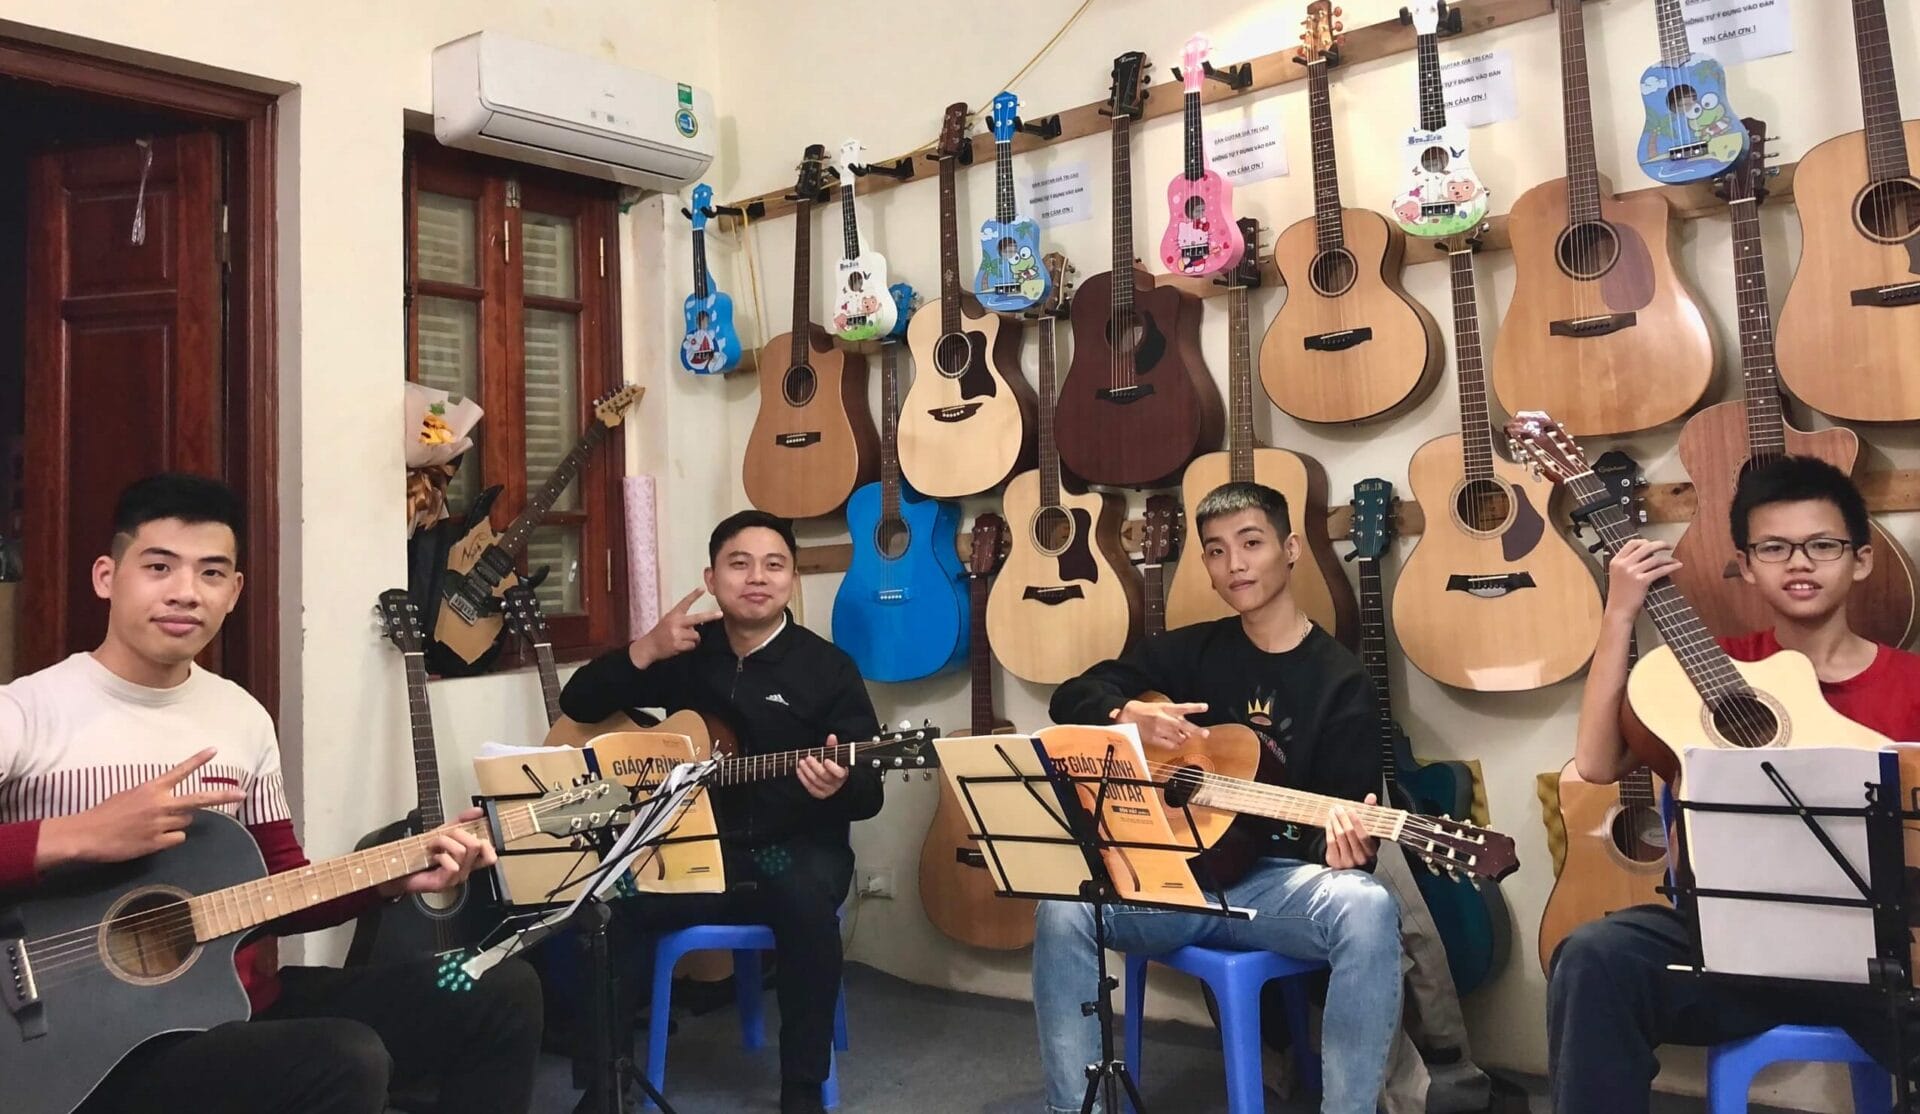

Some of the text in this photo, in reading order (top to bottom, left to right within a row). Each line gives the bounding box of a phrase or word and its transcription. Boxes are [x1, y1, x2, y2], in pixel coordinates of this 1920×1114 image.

[1685, 16, 1705, 25] HÔNG
[1702, 34, 1716, 43] XIN
[612, 755, 642, 776] GIÁO
[1068, 753, 1098, 775] GIÁO
